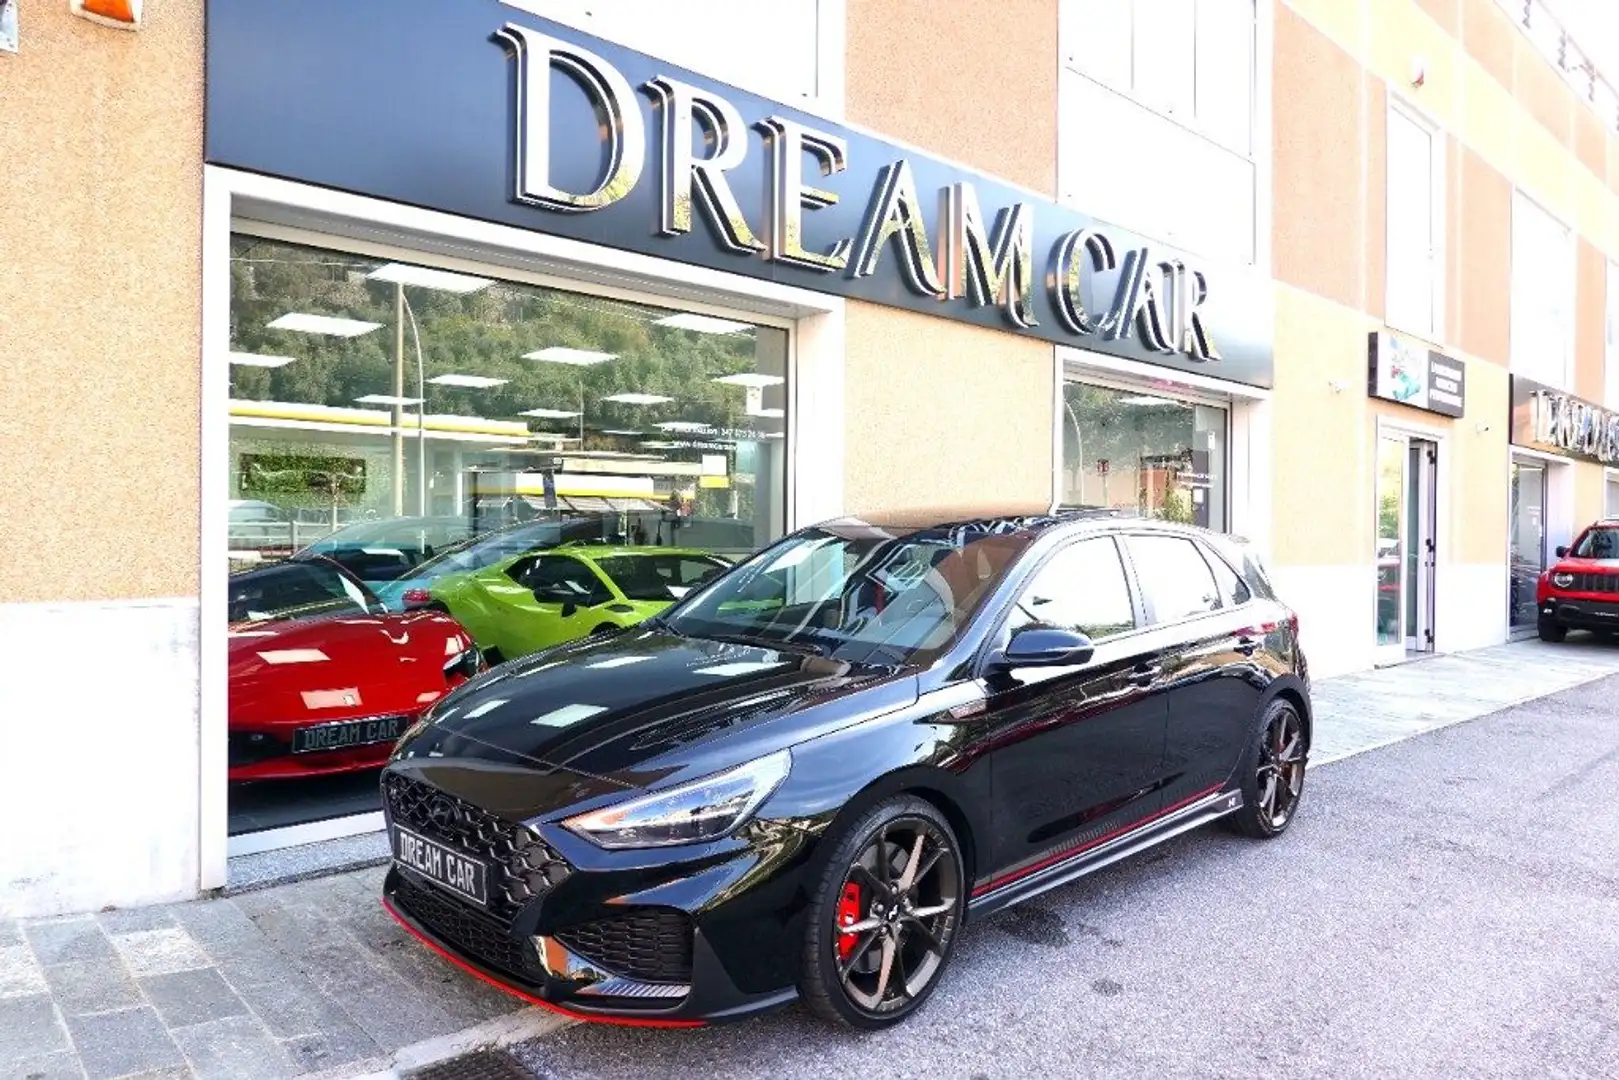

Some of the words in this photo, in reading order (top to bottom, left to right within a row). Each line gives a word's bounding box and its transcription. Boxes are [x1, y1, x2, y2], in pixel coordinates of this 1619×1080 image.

[487, 21, 1039, 329] DREAM
[1045, 227, 1222, 362] CAR
[304, 724, 361, 749] DREAM
[366, 719, 400, 740] CAR
[400, 831, 442, 879] DREAM
[446, 853, 476, 895] CAR
